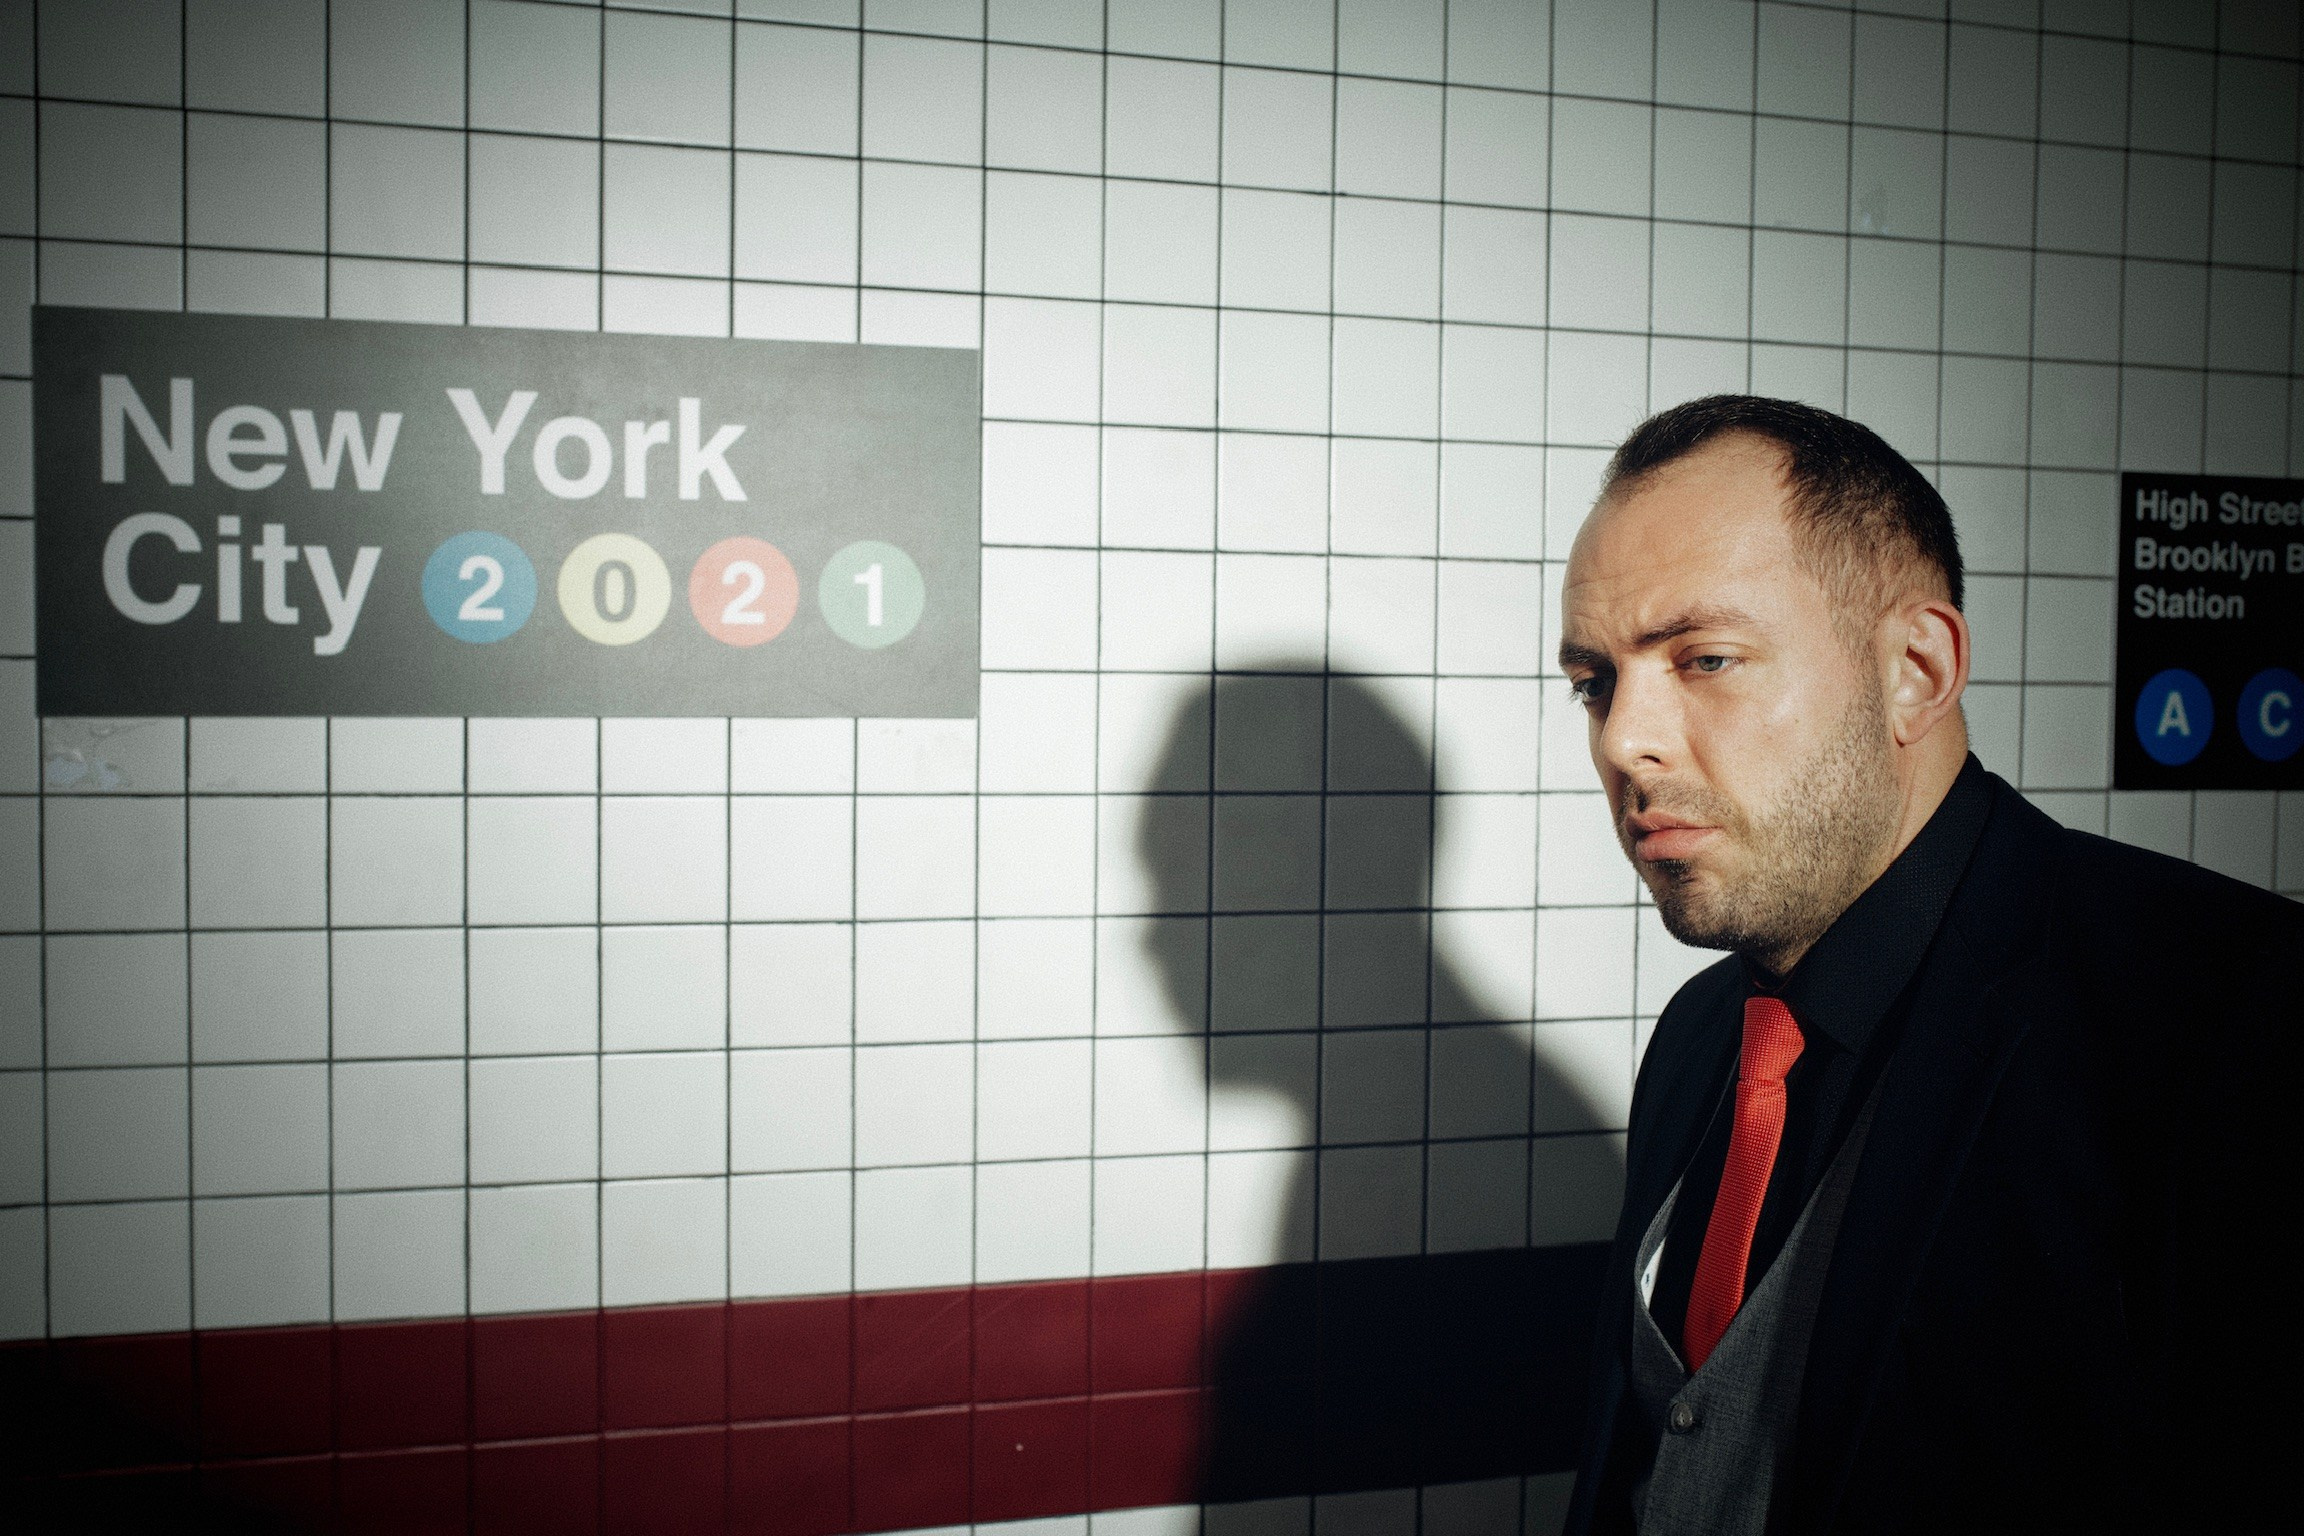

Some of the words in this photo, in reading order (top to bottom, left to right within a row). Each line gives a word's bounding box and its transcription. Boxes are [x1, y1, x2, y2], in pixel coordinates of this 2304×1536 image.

[100, 374, 402, 492] New
[447, 388, 749, 502] York
[2136, 488, 2209, 531] High
[2219, 490, 2304, 527] Stree
[2134, 536, 2276, 581] Brooklyn
[102, 512, 381, 656] City
[2134, 584, 2245, 620] Station
[2157, 690, 2191, 737] A
[2259, 690, 2292, 737] C
